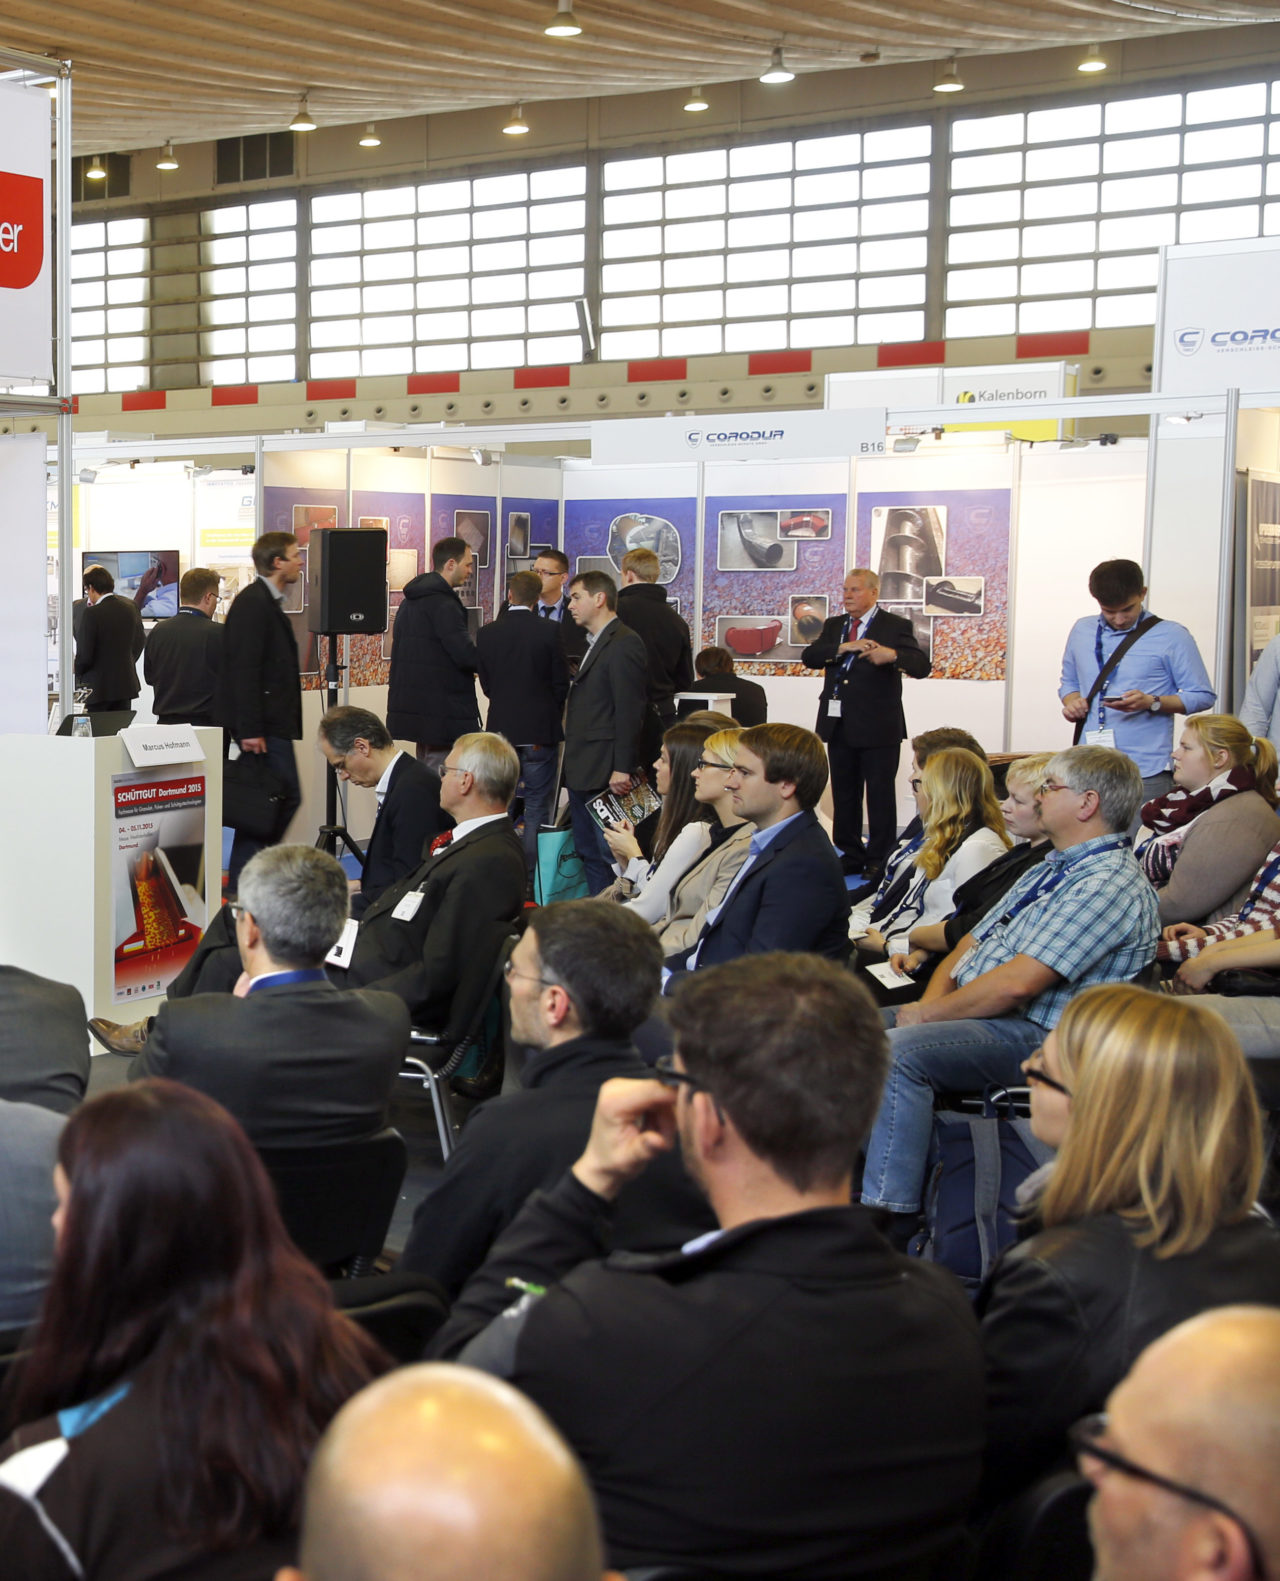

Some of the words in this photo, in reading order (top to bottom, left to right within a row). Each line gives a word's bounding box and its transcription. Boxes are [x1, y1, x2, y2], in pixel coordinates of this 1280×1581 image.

[978, 388, 1047, 402] Kalenborn
[706, 430, 785, 443] CORODUR
[860, 442, 884, 453] B16
[142, 743, 164, 752] Marcus
[165, 740, 190, 750] Hofmann
[117, 788, 156, 803] SCHÜTTGUT
[158, 784, 187, 796] Dortmund
[188, 783, 202, 793] 2015
[119, 842, 139, 851] Dortmund
